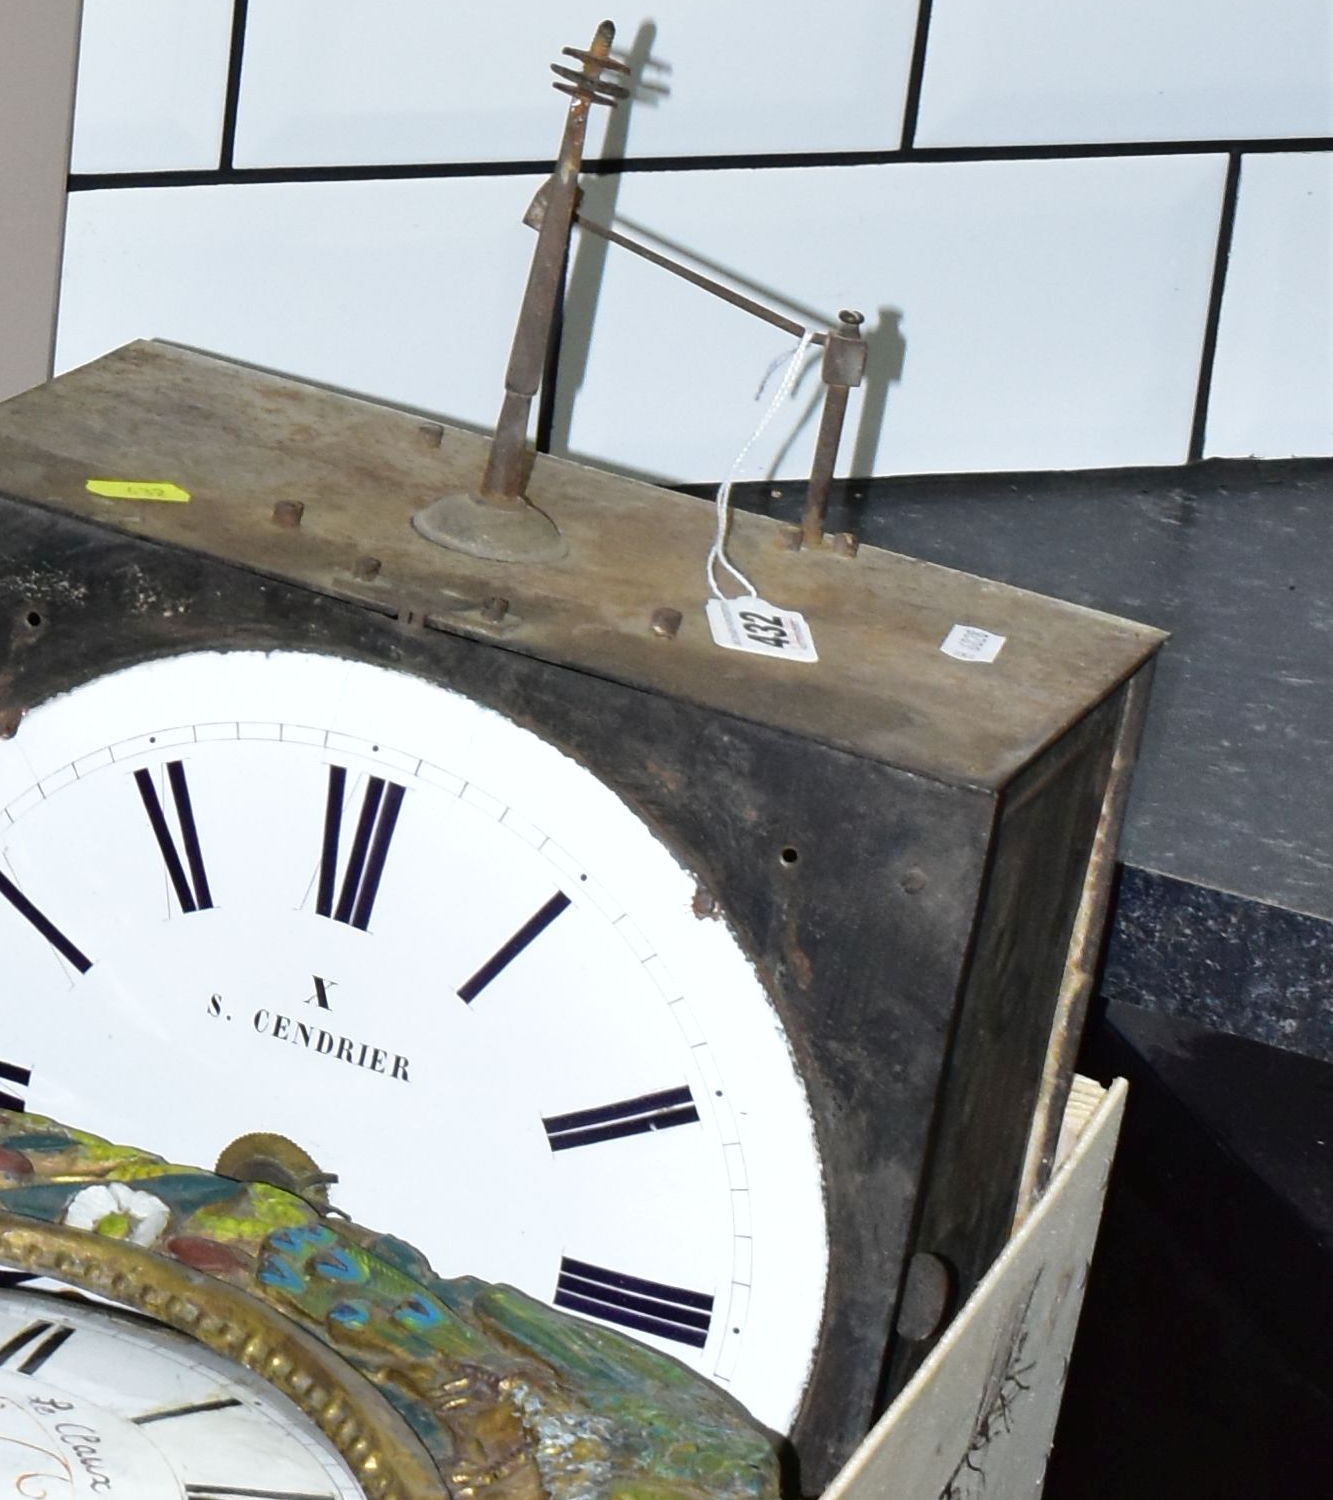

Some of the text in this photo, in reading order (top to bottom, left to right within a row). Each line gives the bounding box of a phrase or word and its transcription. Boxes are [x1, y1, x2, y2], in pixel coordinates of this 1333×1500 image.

[738, 610, 790, 649] 432
[303, 975, 339, 1011] X
[207, 993, 411, 1083] S. CENDRIER
[540, 1084, 700, 1152] II
[552, 1255, 716, 1349] III
[55, 1422, 111, 1494] Claux
